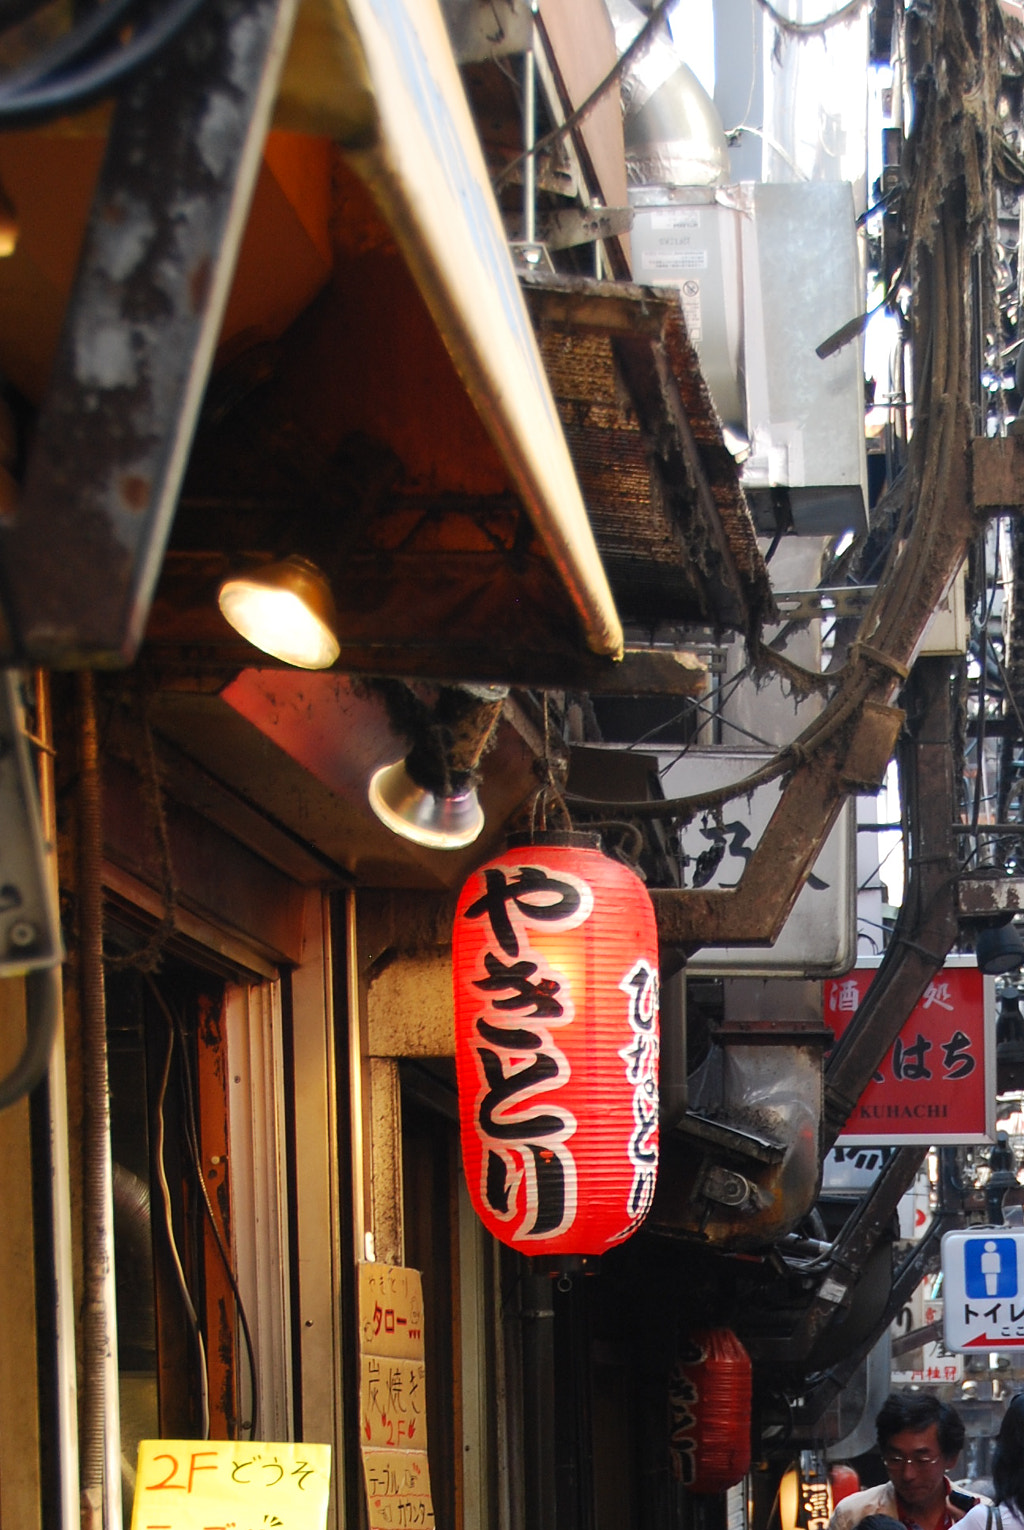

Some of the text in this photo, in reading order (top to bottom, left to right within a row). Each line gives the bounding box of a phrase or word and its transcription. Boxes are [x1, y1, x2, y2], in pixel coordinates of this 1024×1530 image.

[463, 866, 584, 1238] やきとり
[858, 1104, 949, 1119] KUHACHI
[373, 1300, 408, 1337] タロー
[365, 1358, 422, 1415] 炭焼き
[385, 1419, 406, 1446] 2F
[144, 1450, 219, 1495] 2F
[368, 1463, 401, 1496] テーブル
